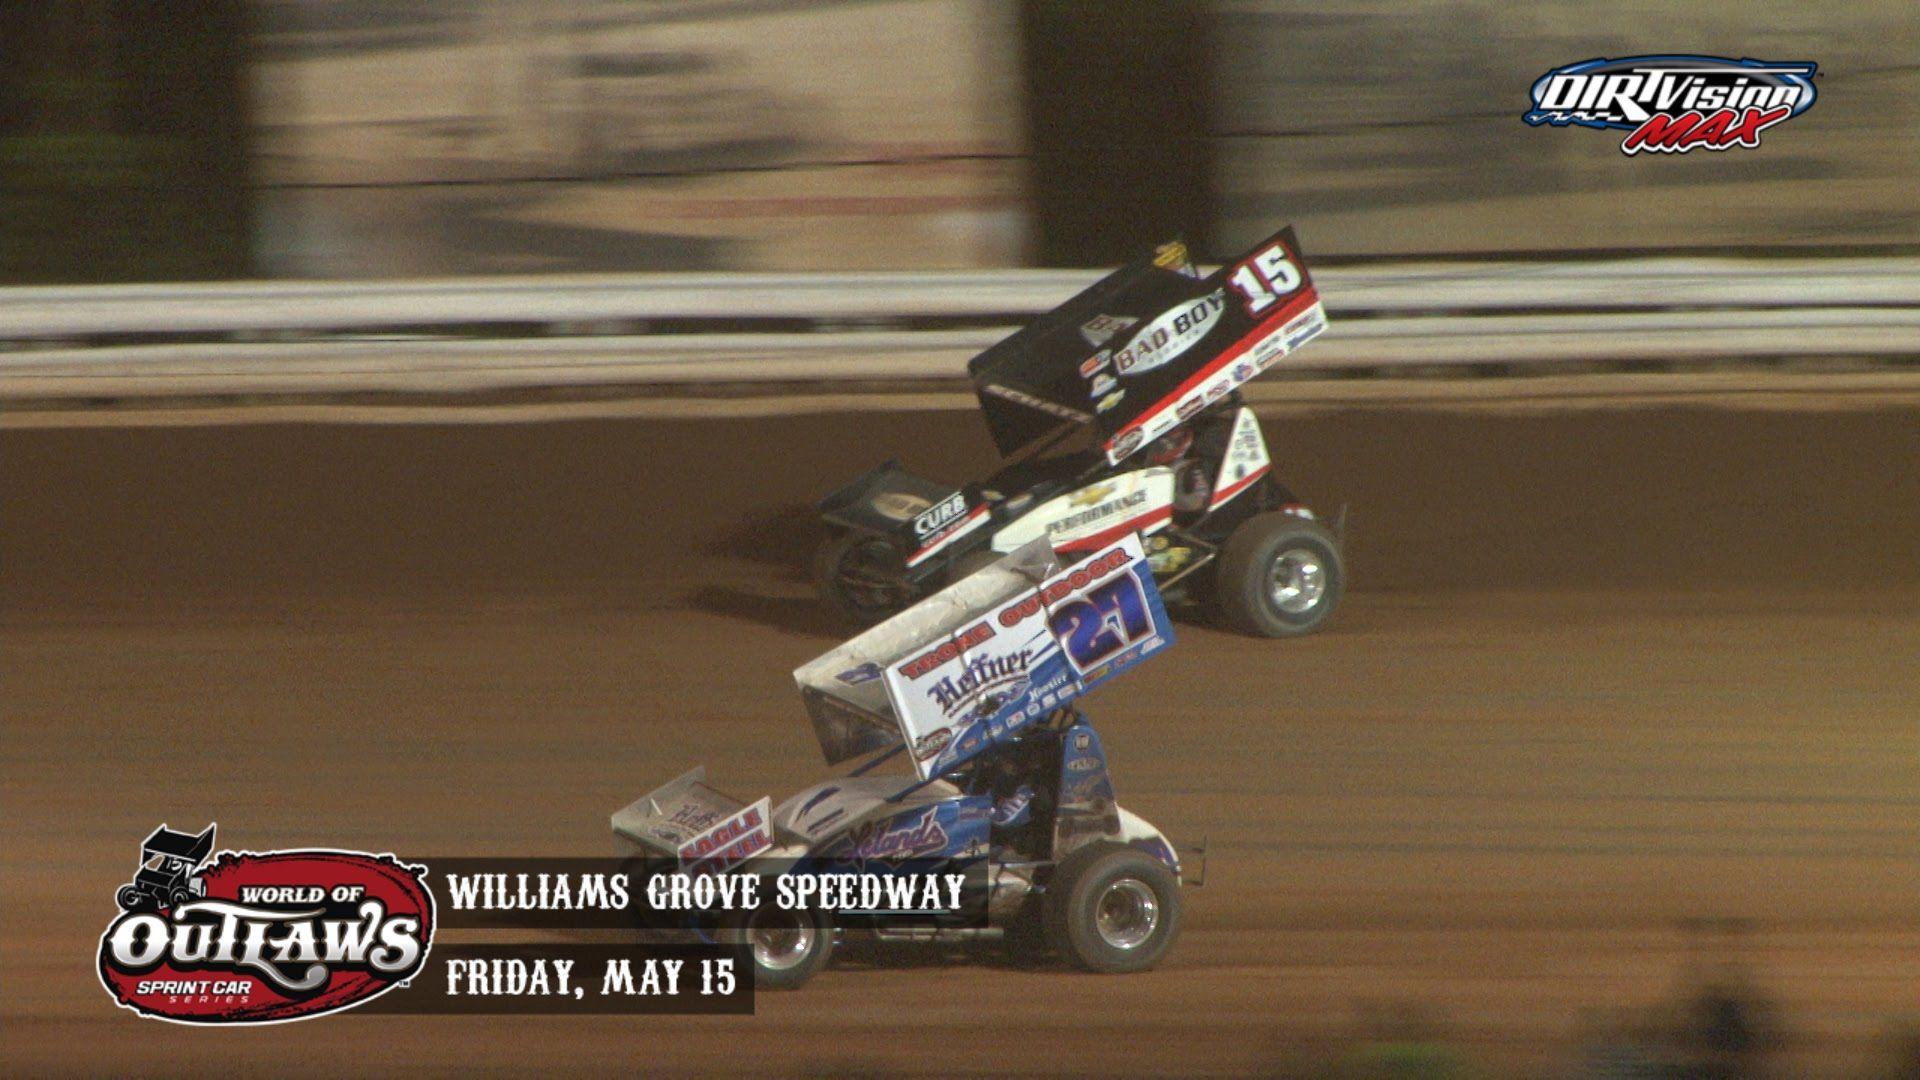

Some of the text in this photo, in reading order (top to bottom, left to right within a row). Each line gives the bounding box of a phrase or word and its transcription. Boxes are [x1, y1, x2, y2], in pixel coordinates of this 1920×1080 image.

[1231, 244, 1302, 315] 15
[1116, 326, 1170, 373] BAD
[1172, 288, 1226, 337] BOY
[914, 494, 966, 535] CURB
[927, 648, 1034, 716] Heffner
